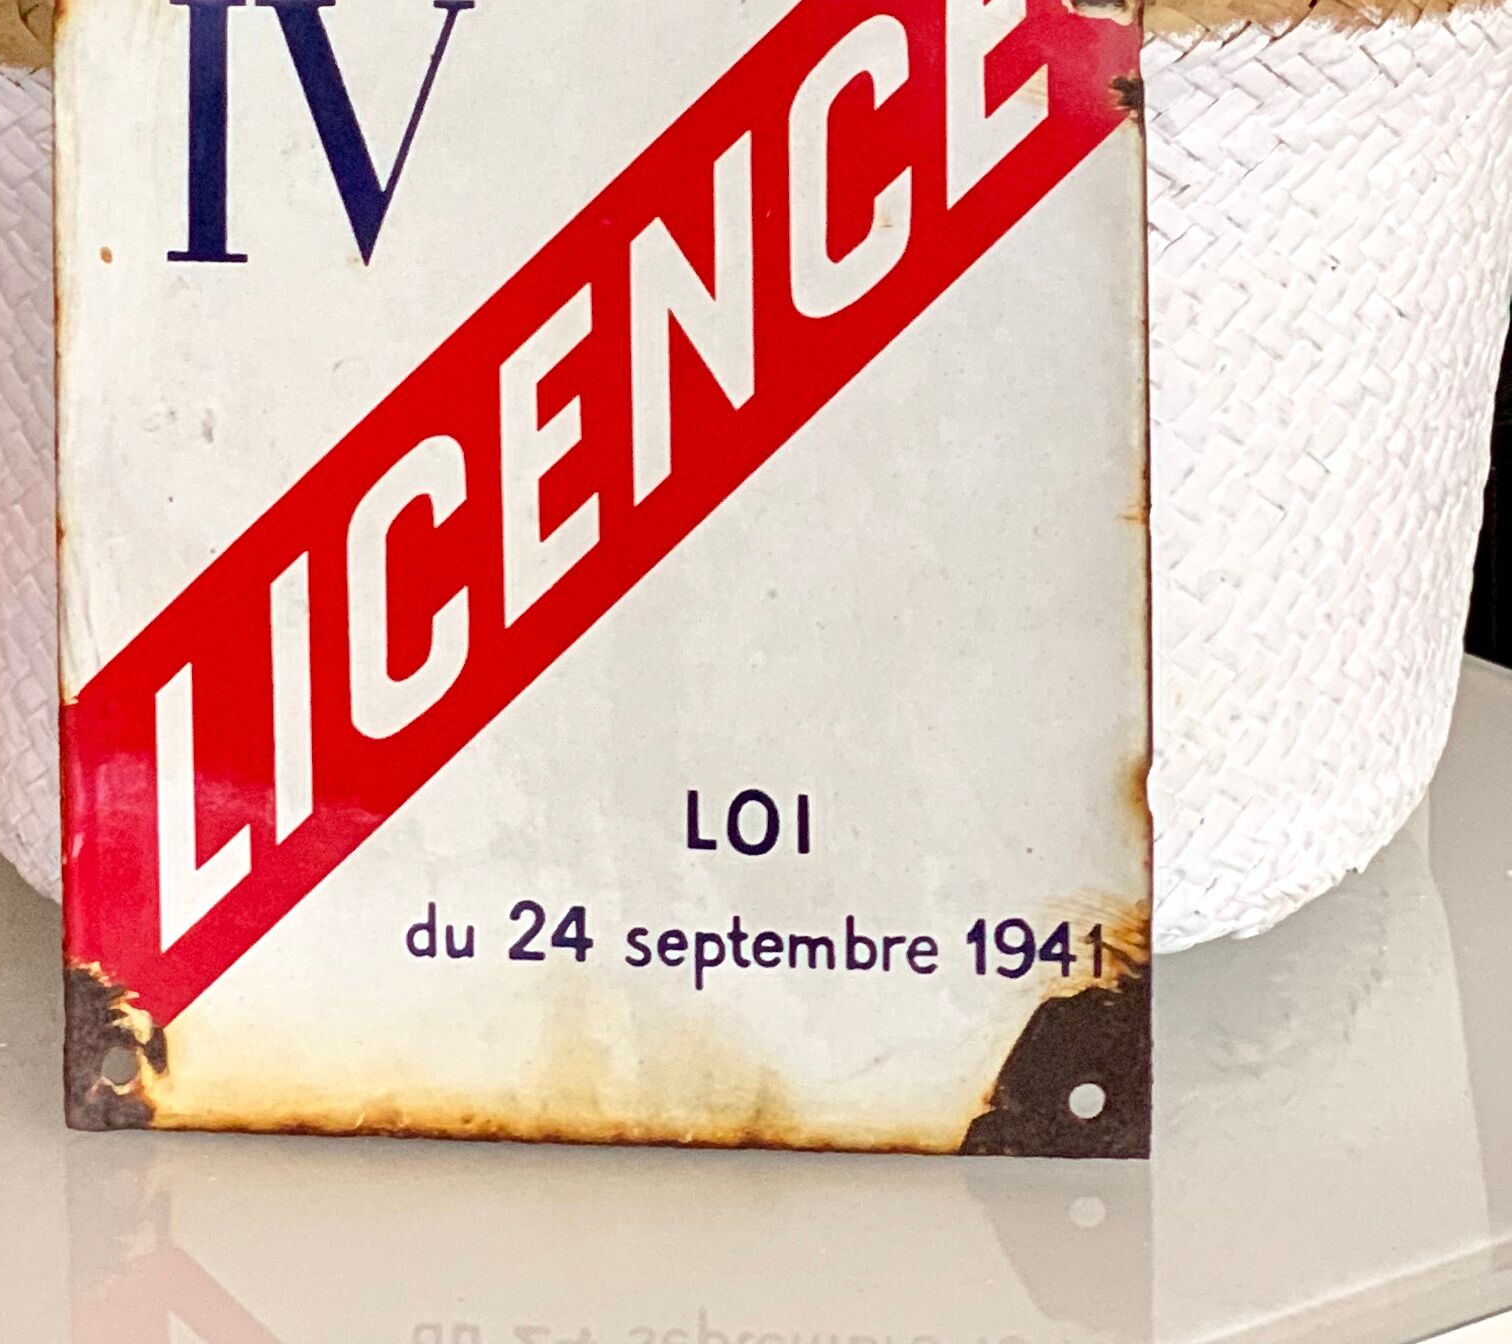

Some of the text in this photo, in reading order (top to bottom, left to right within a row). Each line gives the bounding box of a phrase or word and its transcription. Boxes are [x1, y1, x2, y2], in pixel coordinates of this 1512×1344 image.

[687, 788, 810, 856] LOI
[406, 900, 1103, 992] du 24 septembre 1941
